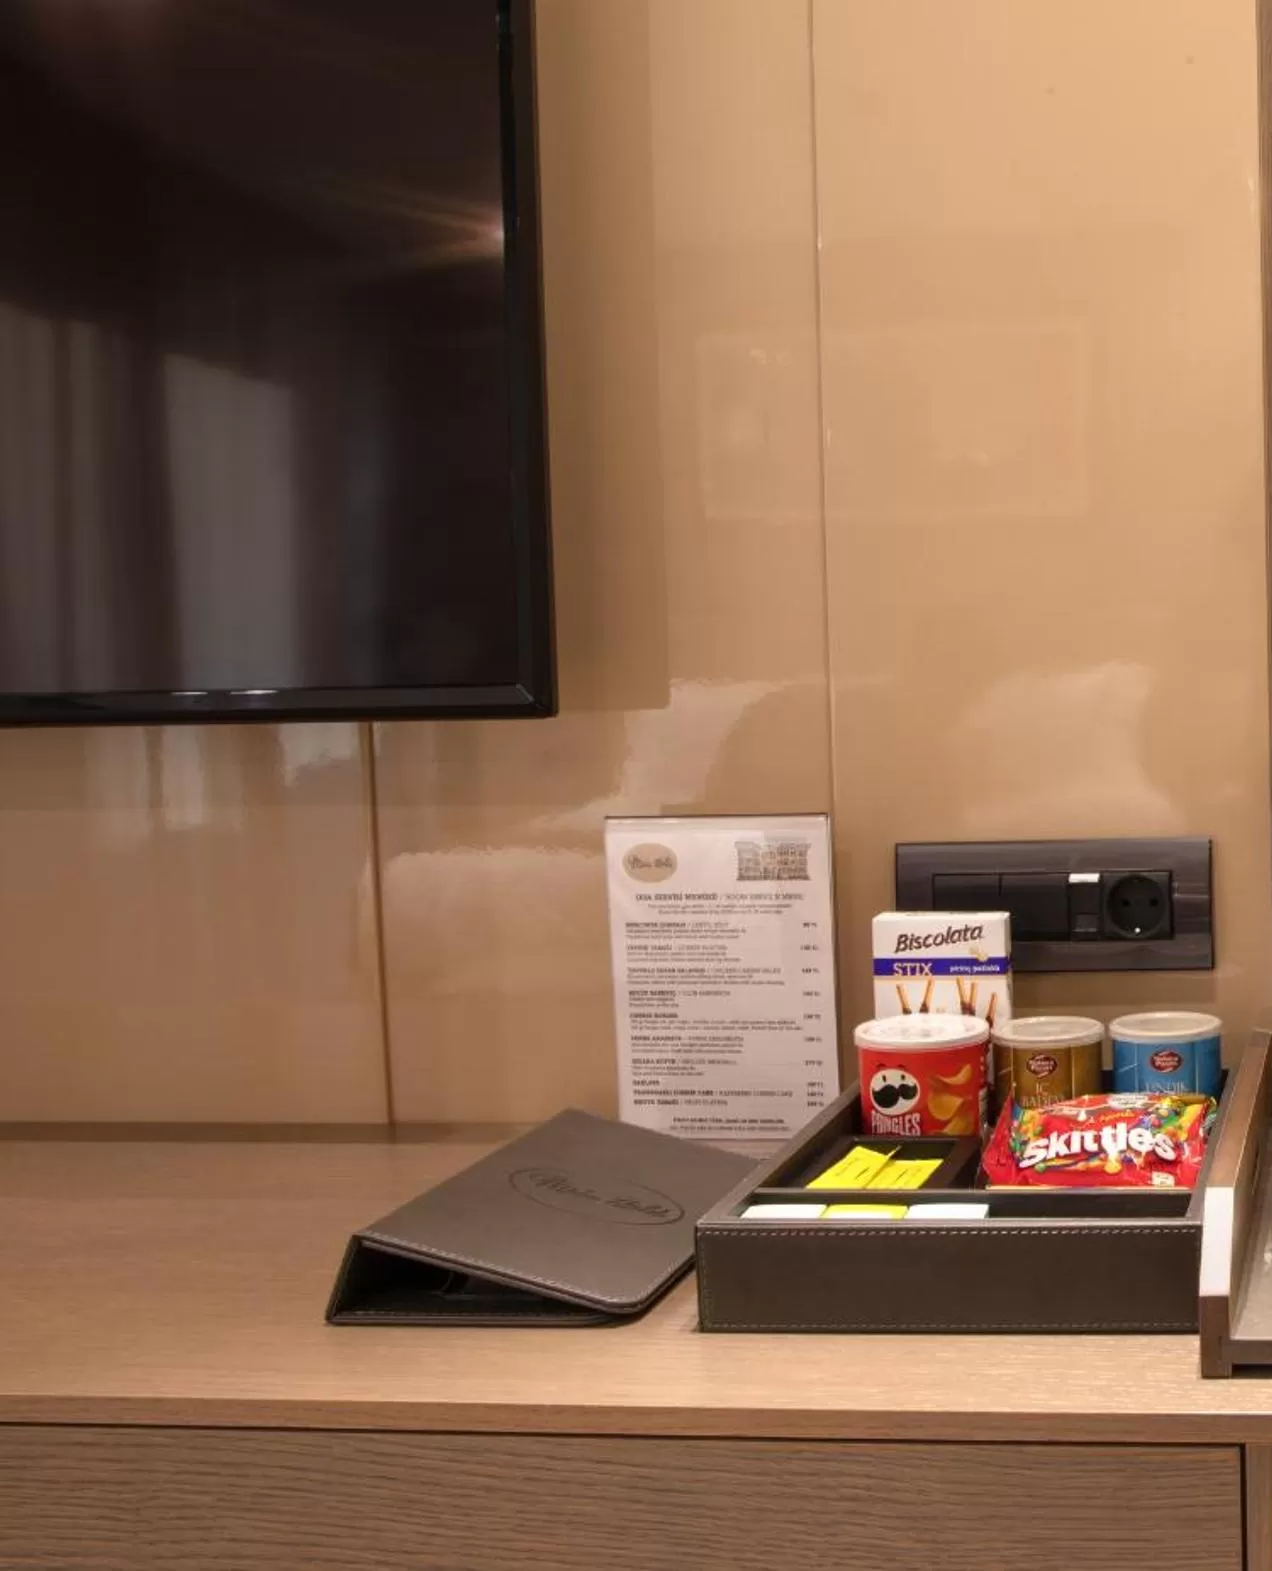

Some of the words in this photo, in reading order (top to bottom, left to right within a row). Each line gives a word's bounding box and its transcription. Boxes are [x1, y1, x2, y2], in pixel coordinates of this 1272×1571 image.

[894, 924, 984, 954] Biscolata
[893, 962, 933, 976] STIX
[871, 1109, 922, 1137] PRINGLES
